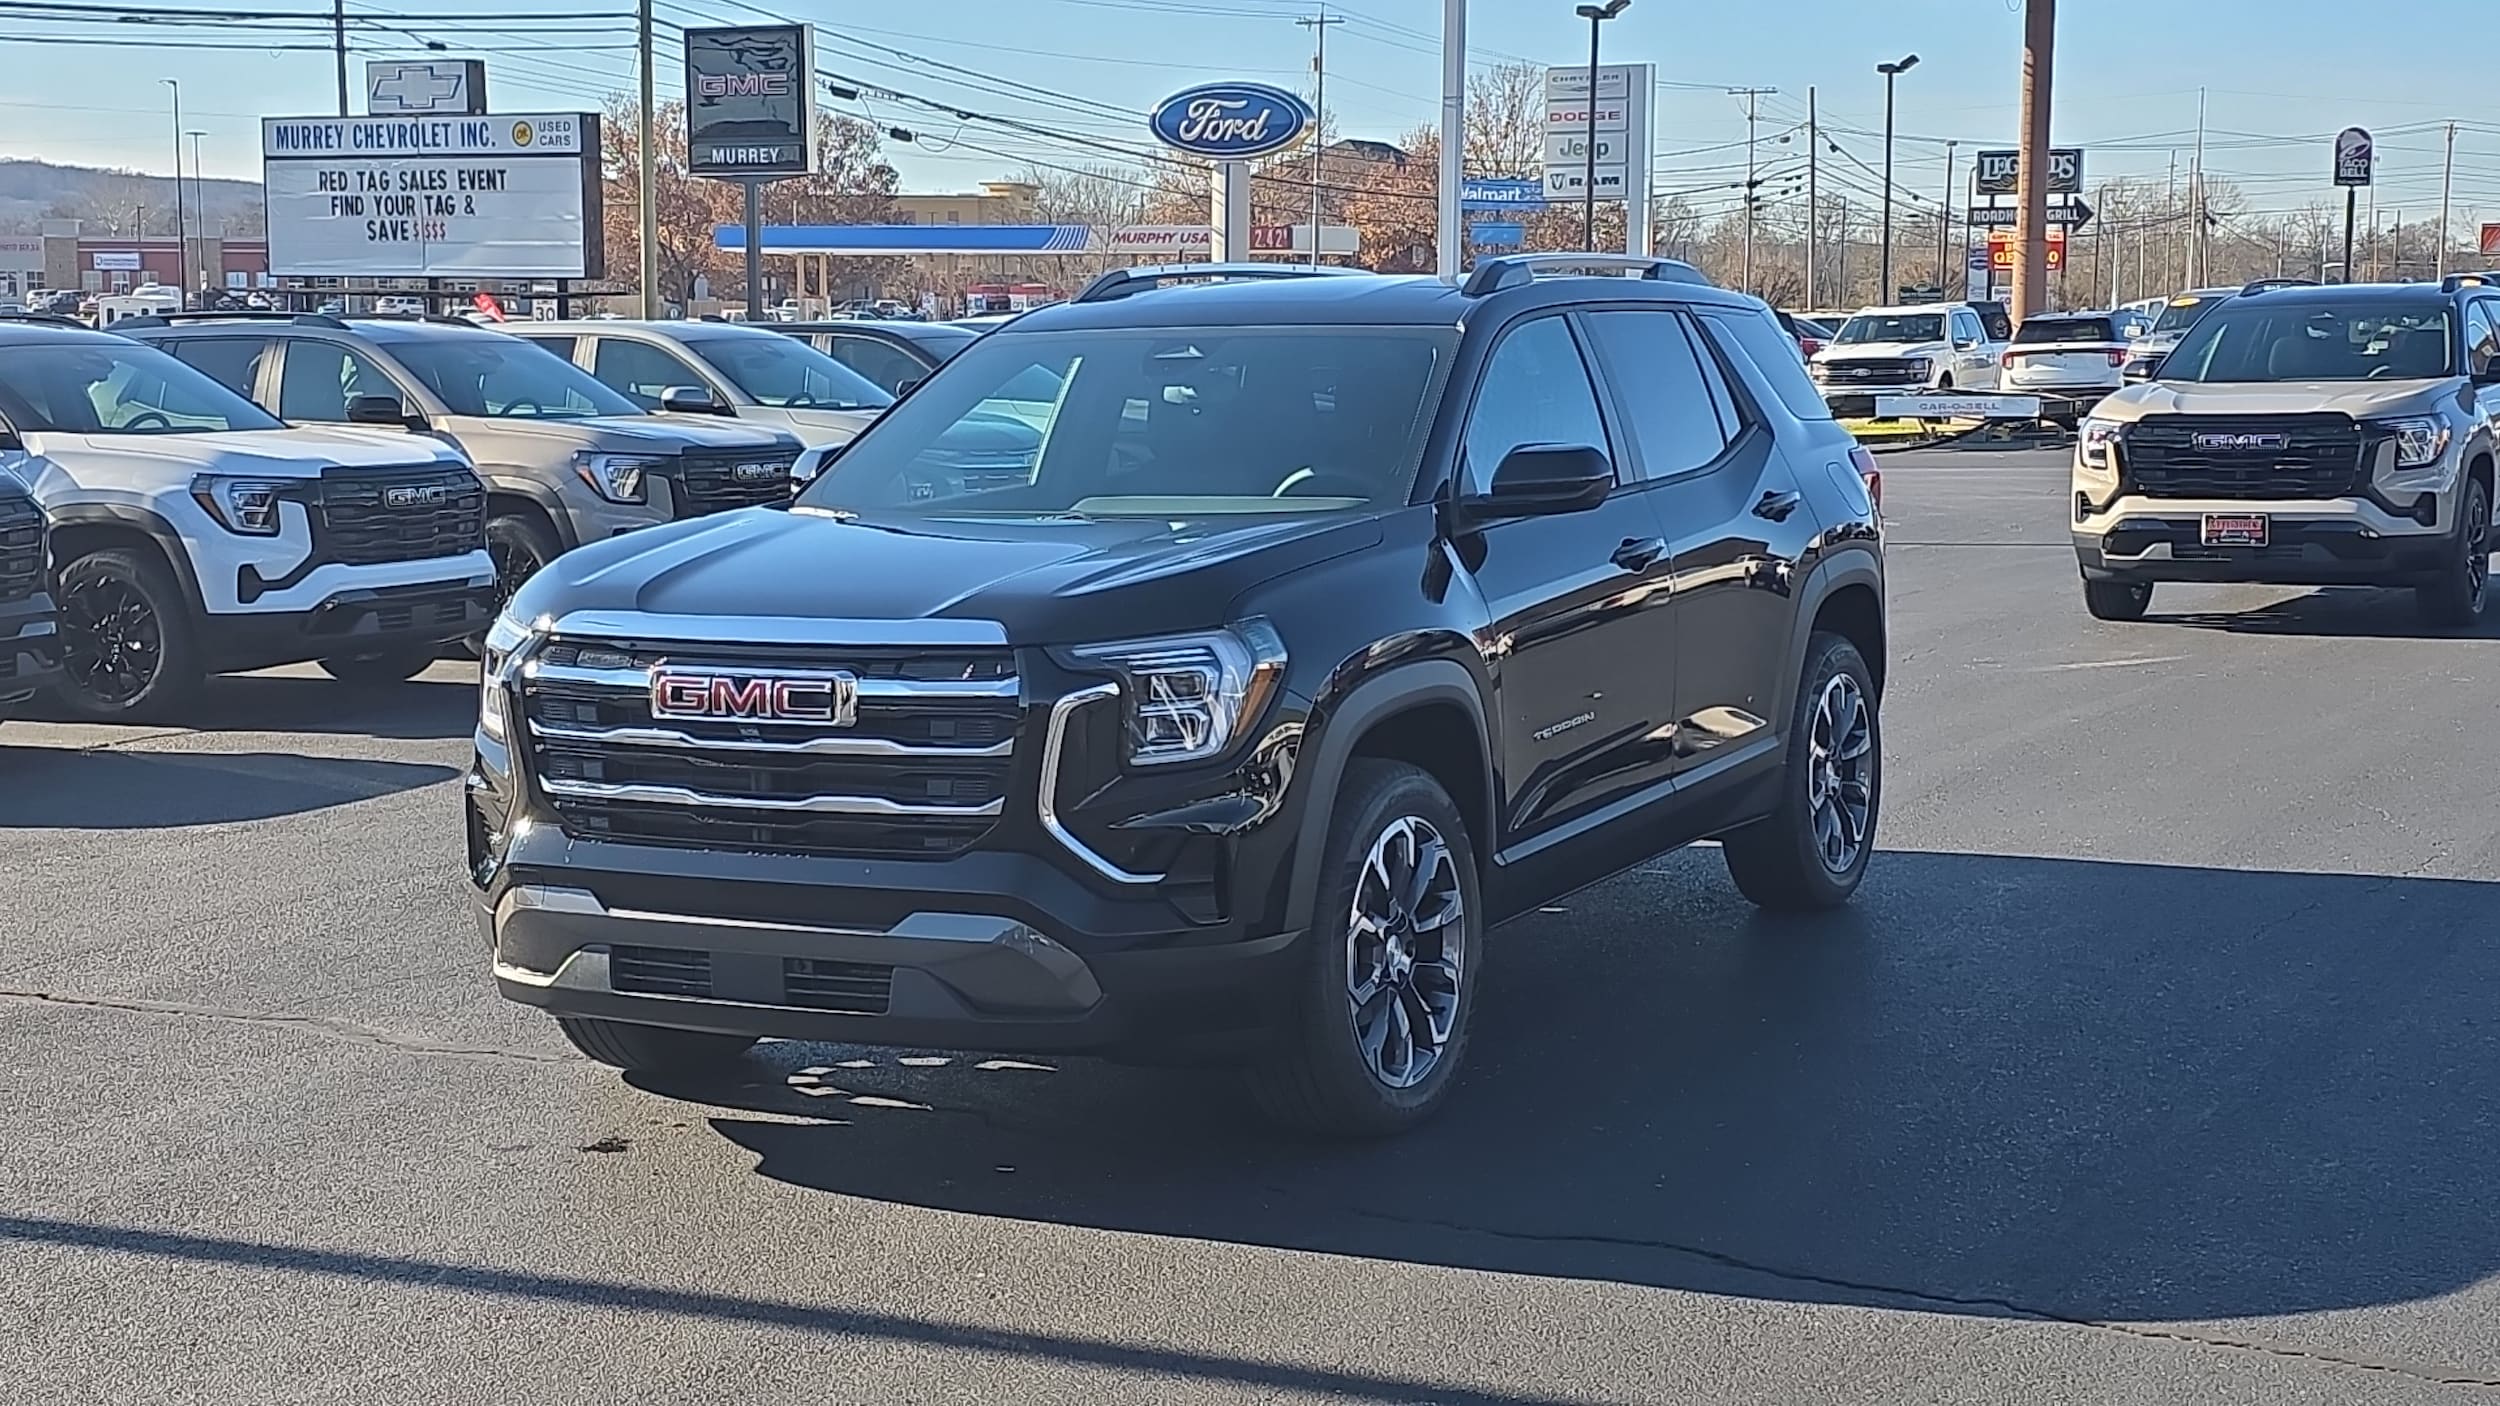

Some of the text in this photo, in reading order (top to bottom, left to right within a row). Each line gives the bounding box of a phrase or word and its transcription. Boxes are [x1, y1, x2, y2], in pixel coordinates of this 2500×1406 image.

[697, 73, 788, 96] GMC
[1179, 98, 1272, 142] Ford
[1550, 111, 1621, 122] DODGE
[538, 121, 571, 132] USED
[275, 122, 496, 150] MURREY CHEVROLET INC.
[539, 135, 571, 146] CARS
[711, 148, 779, 164] MURREY
[1560, 138, 1609, 160] Jep
[1980, 156, 2075, 180] LEGDS
[2339, 159, 2368, 168] TACO
[318, 169, 507, 192] RED TAG SALES EVENT
[2340, 168, 2367, 177] BELL
[1569, 177, 1620, 187] RAM
[331, 195, 475, 216] FIND YOUR TAG &
[2047, 208, 2079, 221] GRILL
[366, 220, 409, 241] SAVE
[1112, 232, 1210, 244] MURPHY USA
[535, 307, 556, 321] 30
[2198, 433, 2283, 450] GMC
[387, 486, 446, 506] GMC
[657, 675, 834, 720] GMC
